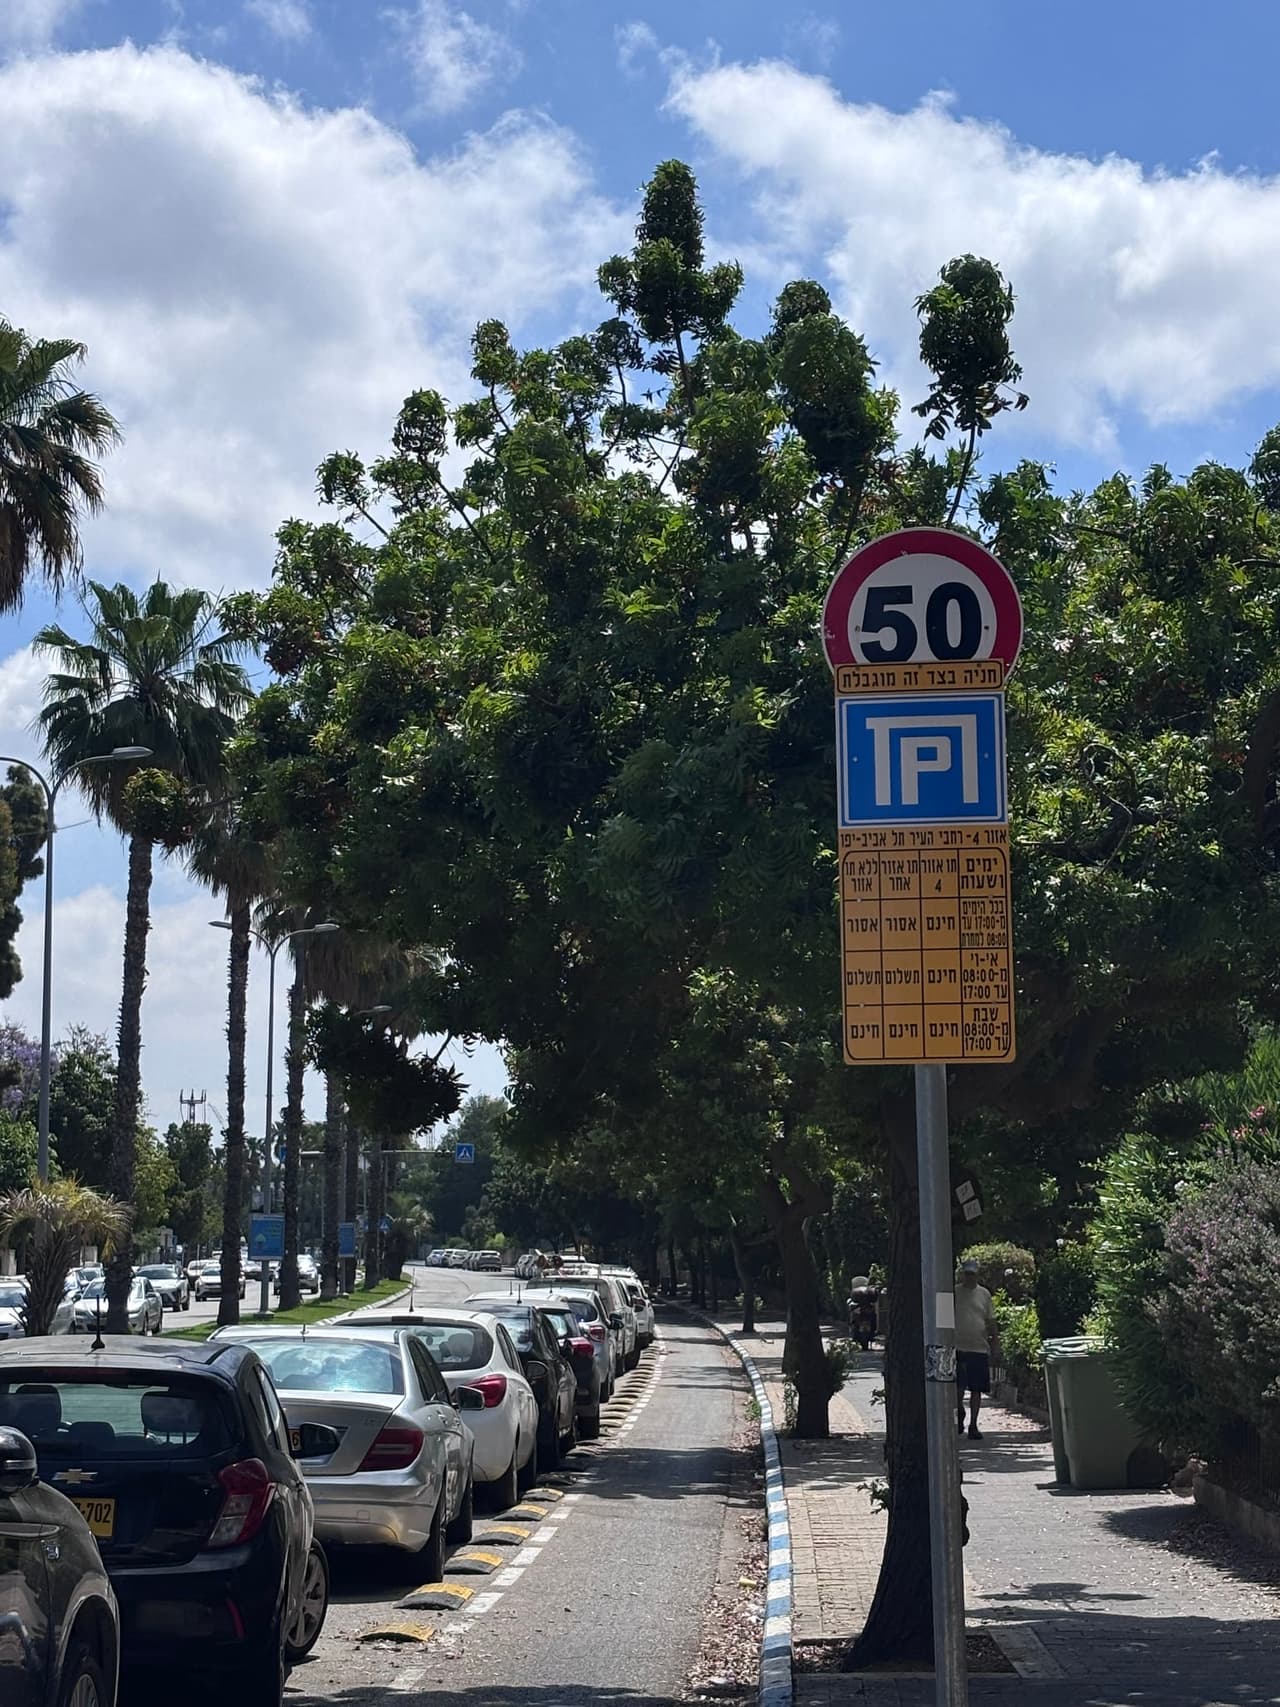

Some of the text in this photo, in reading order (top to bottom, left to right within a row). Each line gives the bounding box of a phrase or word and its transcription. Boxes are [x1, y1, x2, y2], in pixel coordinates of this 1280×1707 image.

[860, 582, 982, 662] 50
[843, 668, 997, 688] חניה בצד זה מוגבלת
[841, 832, 886, 848] אביב-יפו
[892, 830, 904, 846] תל
[910, 832, 933, 846] העיר
[940, 832, 963, 844] רחבי
[984, 830, 1007, 843] אזור
[858, 858, 878, 875] ללא
[882, 860, 903, 874] אזור
[922, 859, 943, 873] אזור
[967, 858, 998, 872] ימים
[851, 878, 872, 892] אזור
[889, 877, 910, 890] אחר
[935, 879, 942, 892] 4
[961, 874, 1003, 889] ושעות
[962, 899, 1003, 915] בכל הימים
[848, 918, 878, 932] אסור
[886, 918, 916, 931] אסור
[927, 916, 955, 931] חינם
[962, 916, 972, 929] עד
[847, 968, 881, 986] תשלום
[886, 968, 920, 985] תשלום
[928, 969, 956, 983] חינם
[964, 985, 1008, 999] עד 17:00
[973, 1007, 999, 1022] שבת
[851, 1024, 879, 1039] חינם
[889, 1024, 918, 1038] חינם
[930, 1023, 958, 1037] חינם
[965, 1037, 1008, 1051] עד 17:00
